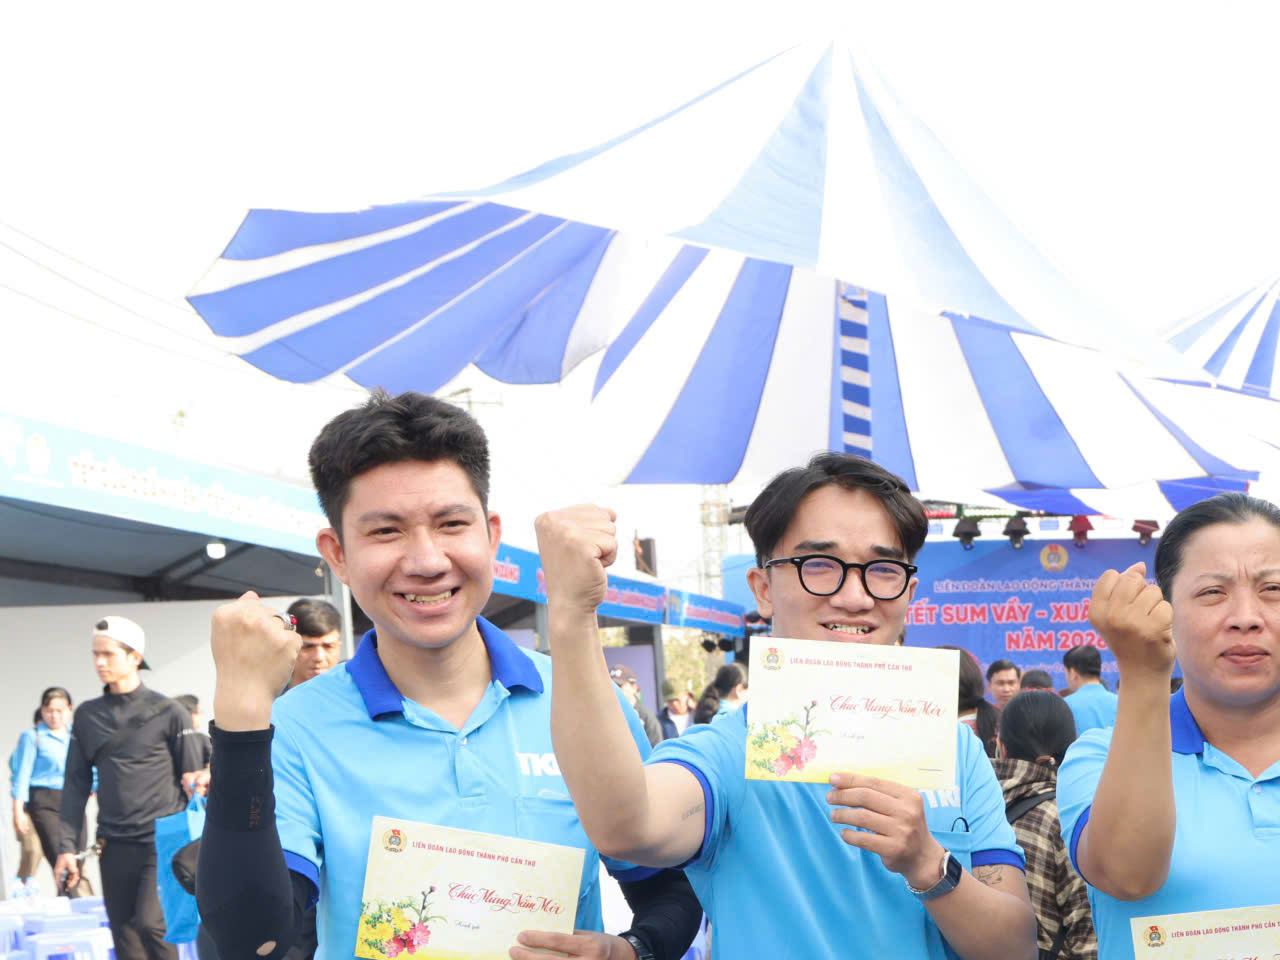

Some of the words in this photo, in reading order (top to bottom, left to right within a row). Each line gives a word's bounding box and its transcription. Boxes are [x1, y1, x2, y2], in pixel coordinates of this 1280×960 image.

[998, 580, 1020, 592] LAO
[1022, 578, 1057, 594] ĐỘNG
[904, 598, 937, 624] TẾT
[941, 604, 988, 624] SUM
[1006, 626, 1055, 650] NĂM
[516, 752, 561, 776] TK
[445, 846, 457, 854] LAO
[448, 882, 479, 903] Chúc
[479, 887, 512, 912] Mừng
